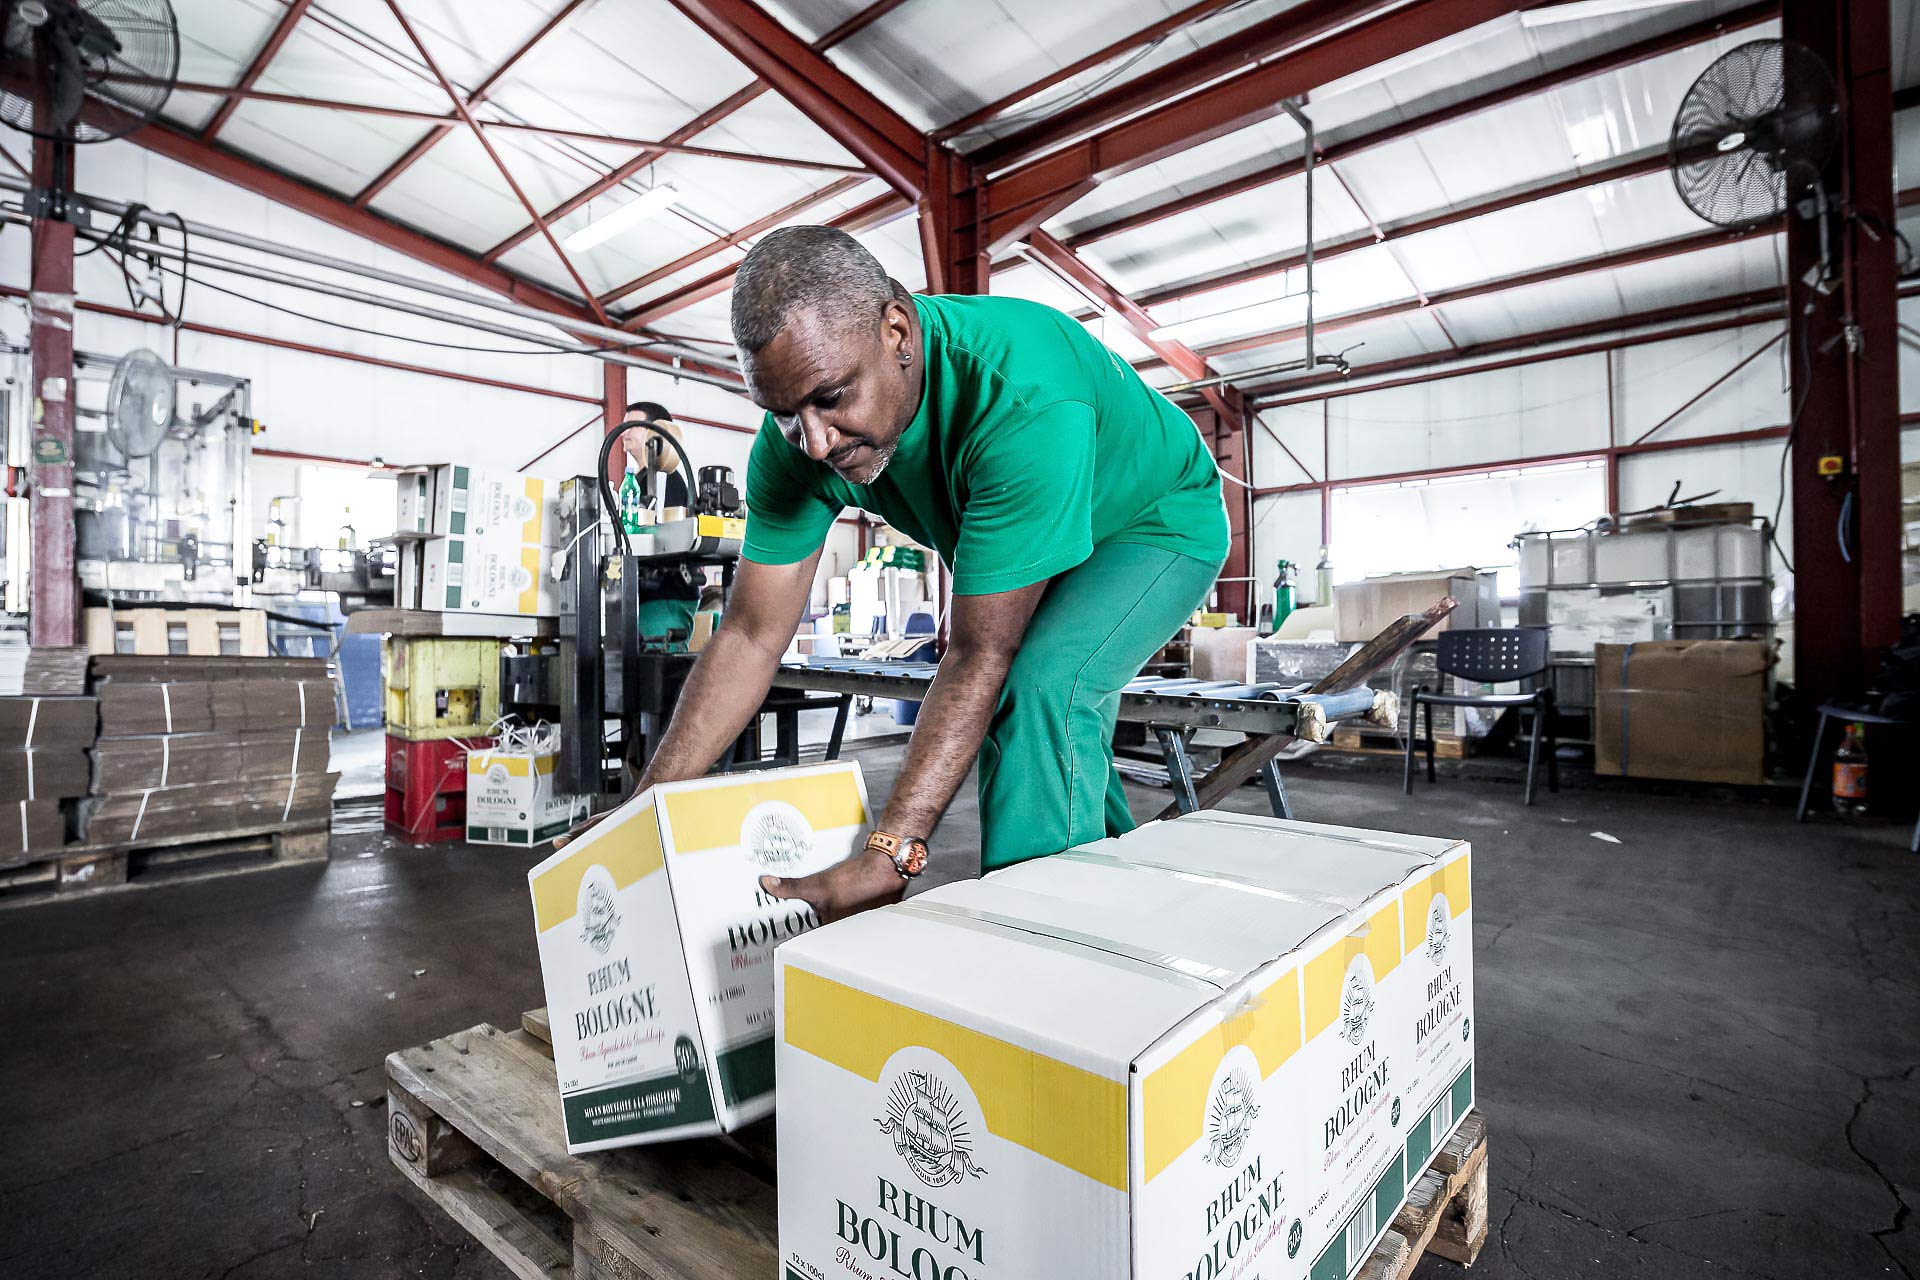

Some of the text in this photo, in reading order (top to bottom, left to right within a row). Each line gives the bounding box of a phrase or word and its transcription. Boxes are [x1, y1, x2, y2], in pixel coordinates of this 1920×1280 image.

[587, 956, 631, 996] RHUM
[1427, 965, 1453, 1002] RHUM
[575, 983, 660, 1041] BOLOGNE
[1416, 982, 1462, 1045] BOLOGNE
[1341, 1040, 1376, 1093] RHUM
[1324, 1056, 1391, 1151] BOLOGNE
[909, 1157, 931, 1183] DEPUIS
[1206, 1155, 1262, 1236] RHUM
[877, 1176, 985, 1266] RHUM
[835, 1246, 873, 1280] Rhum
